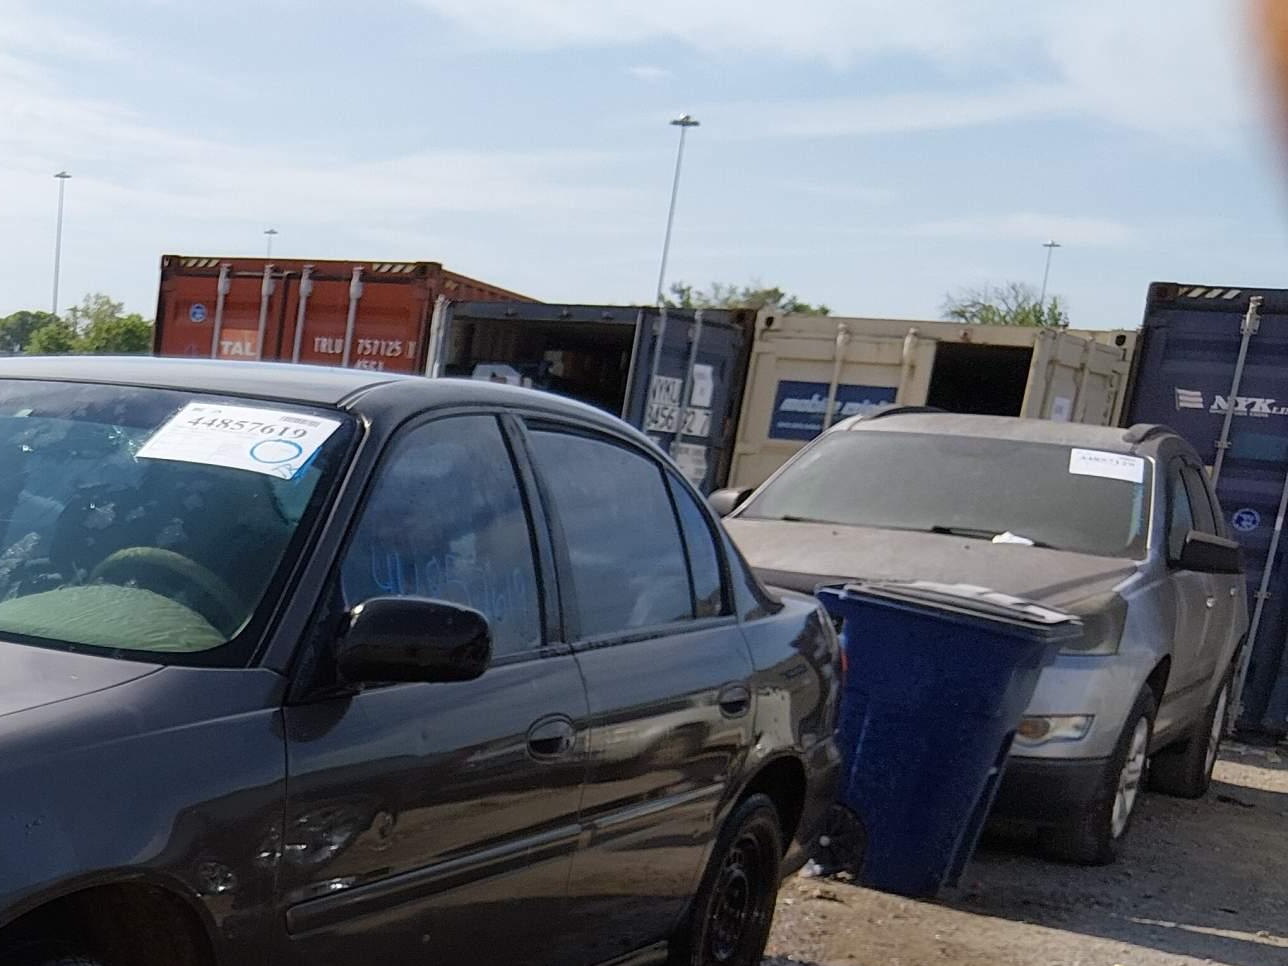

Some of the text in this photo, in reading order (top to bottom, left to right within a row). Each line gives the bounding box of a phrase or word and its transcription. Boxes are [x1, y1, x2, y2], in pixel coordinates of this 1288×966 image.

[220, 339, 257, 356] TAL
[1210, 395, 1276, 413] NYK
[187, 415, 308, 440] 44857619
